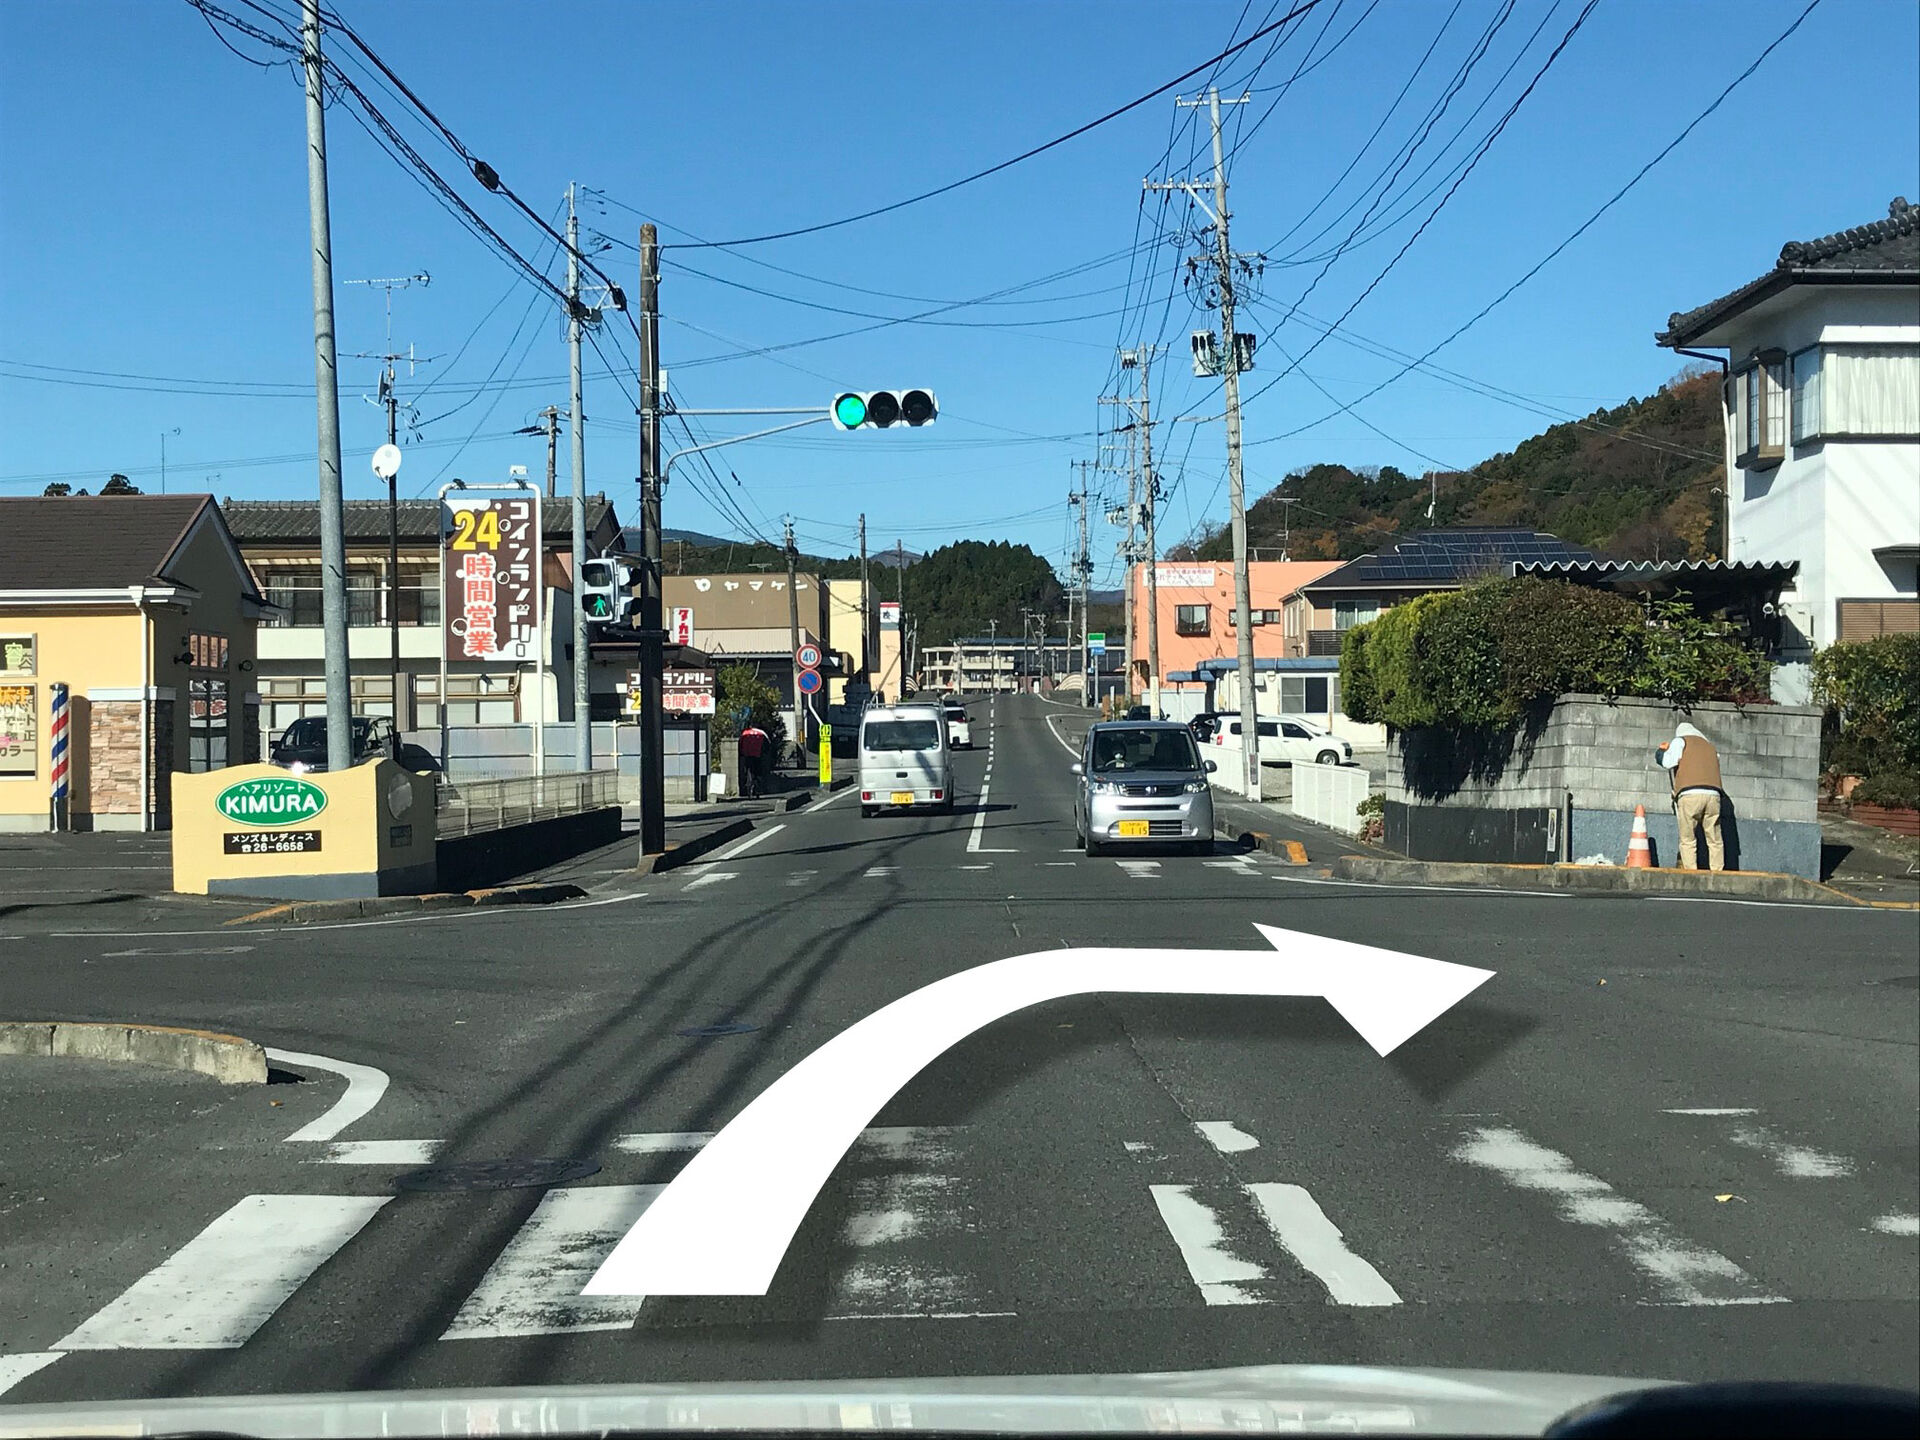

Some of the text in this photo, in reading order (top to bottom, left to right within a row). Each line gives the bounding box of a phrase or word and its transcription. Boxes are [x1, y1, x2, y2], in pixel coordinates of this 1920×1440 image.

[453, 511, 502, 550] 24
[509, 502, 531, 657] コインランドリー
[802, 652, 816, 662] 40
[239, 782, 306, 794] ヘアリゾート
[225, 793, 319, 814] KIMURA
